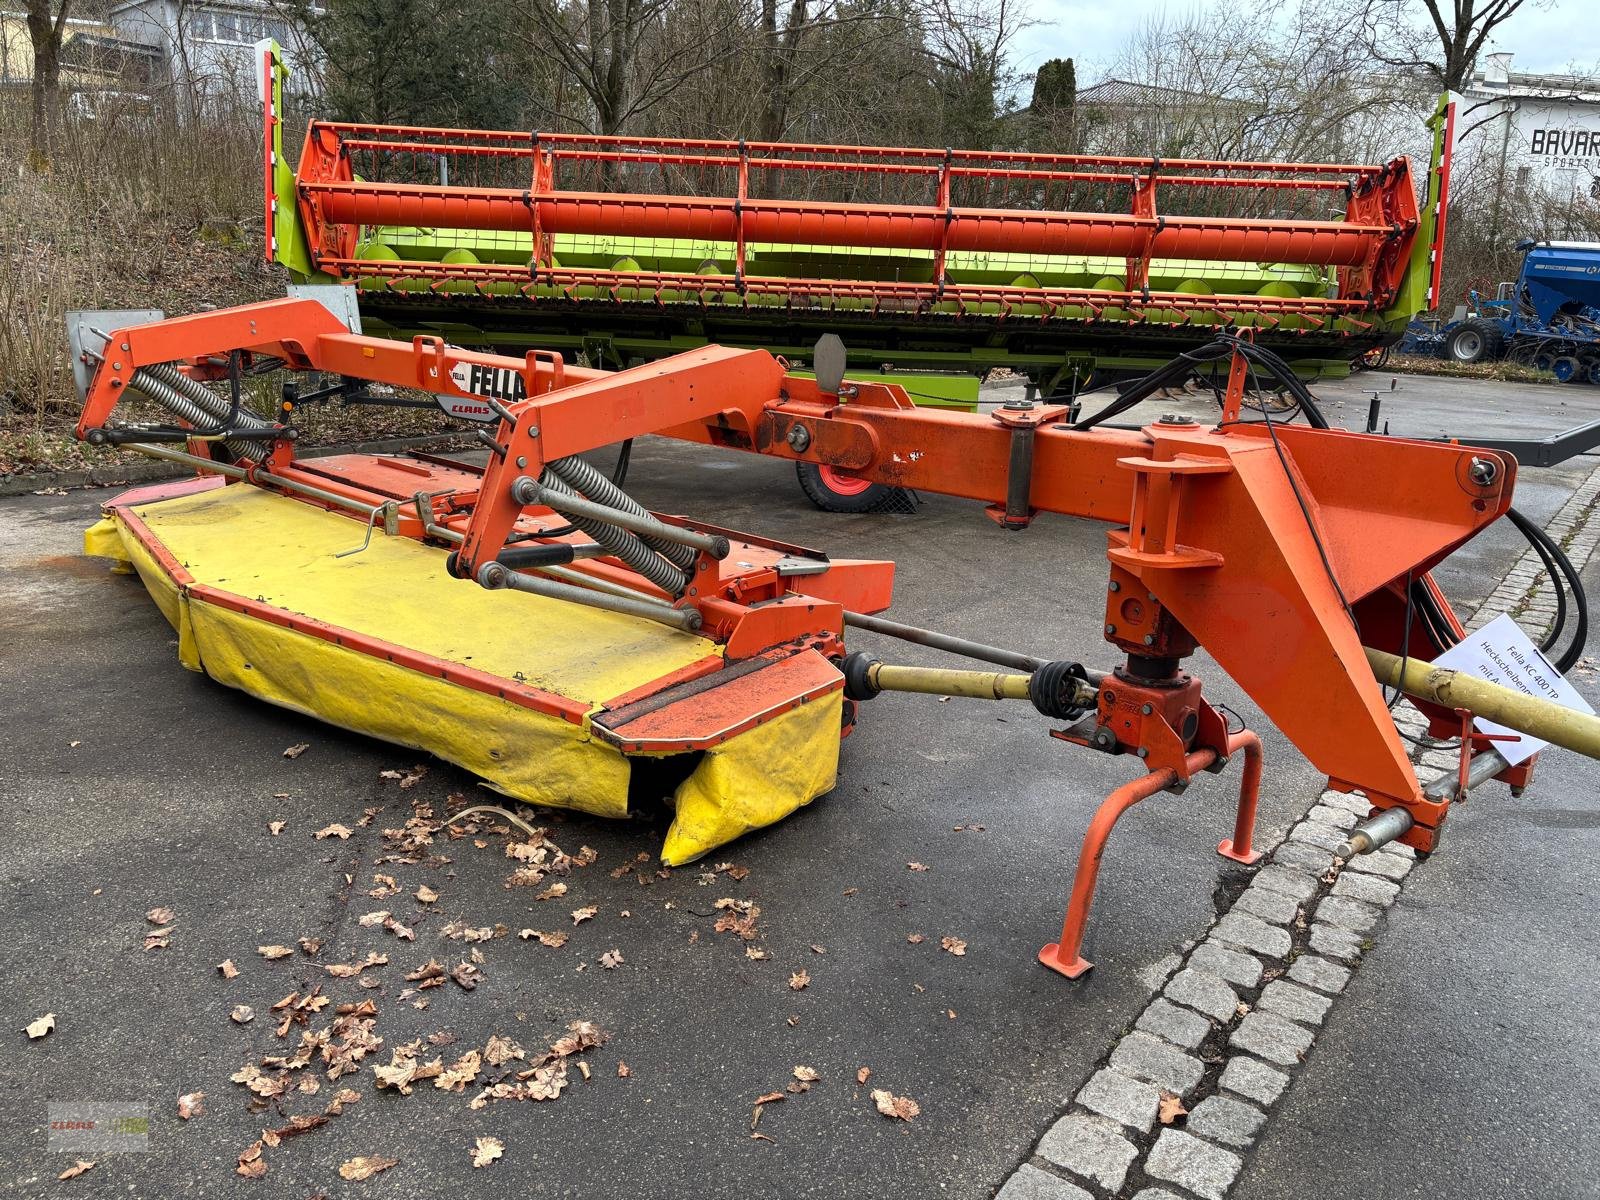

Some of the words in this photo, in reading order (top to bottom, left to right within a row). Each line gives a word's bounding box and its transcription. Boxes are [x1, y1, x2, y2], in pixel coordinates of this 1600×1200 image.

[1545, 157, 1590, 168] SPORTS
[452, 372, 465, 381] FELLA
[470, 365, 528, 402] FELLA
[452, 405, 490, 414] CLAAS
[1479, 664, 1493, 679] mit
[1506, 646, 1525, 665] Fella
[1523, 664, 1537, 676] KC
[1534, 676, 1550, 690] 400
[1547, 688, 1559, 699] TP
